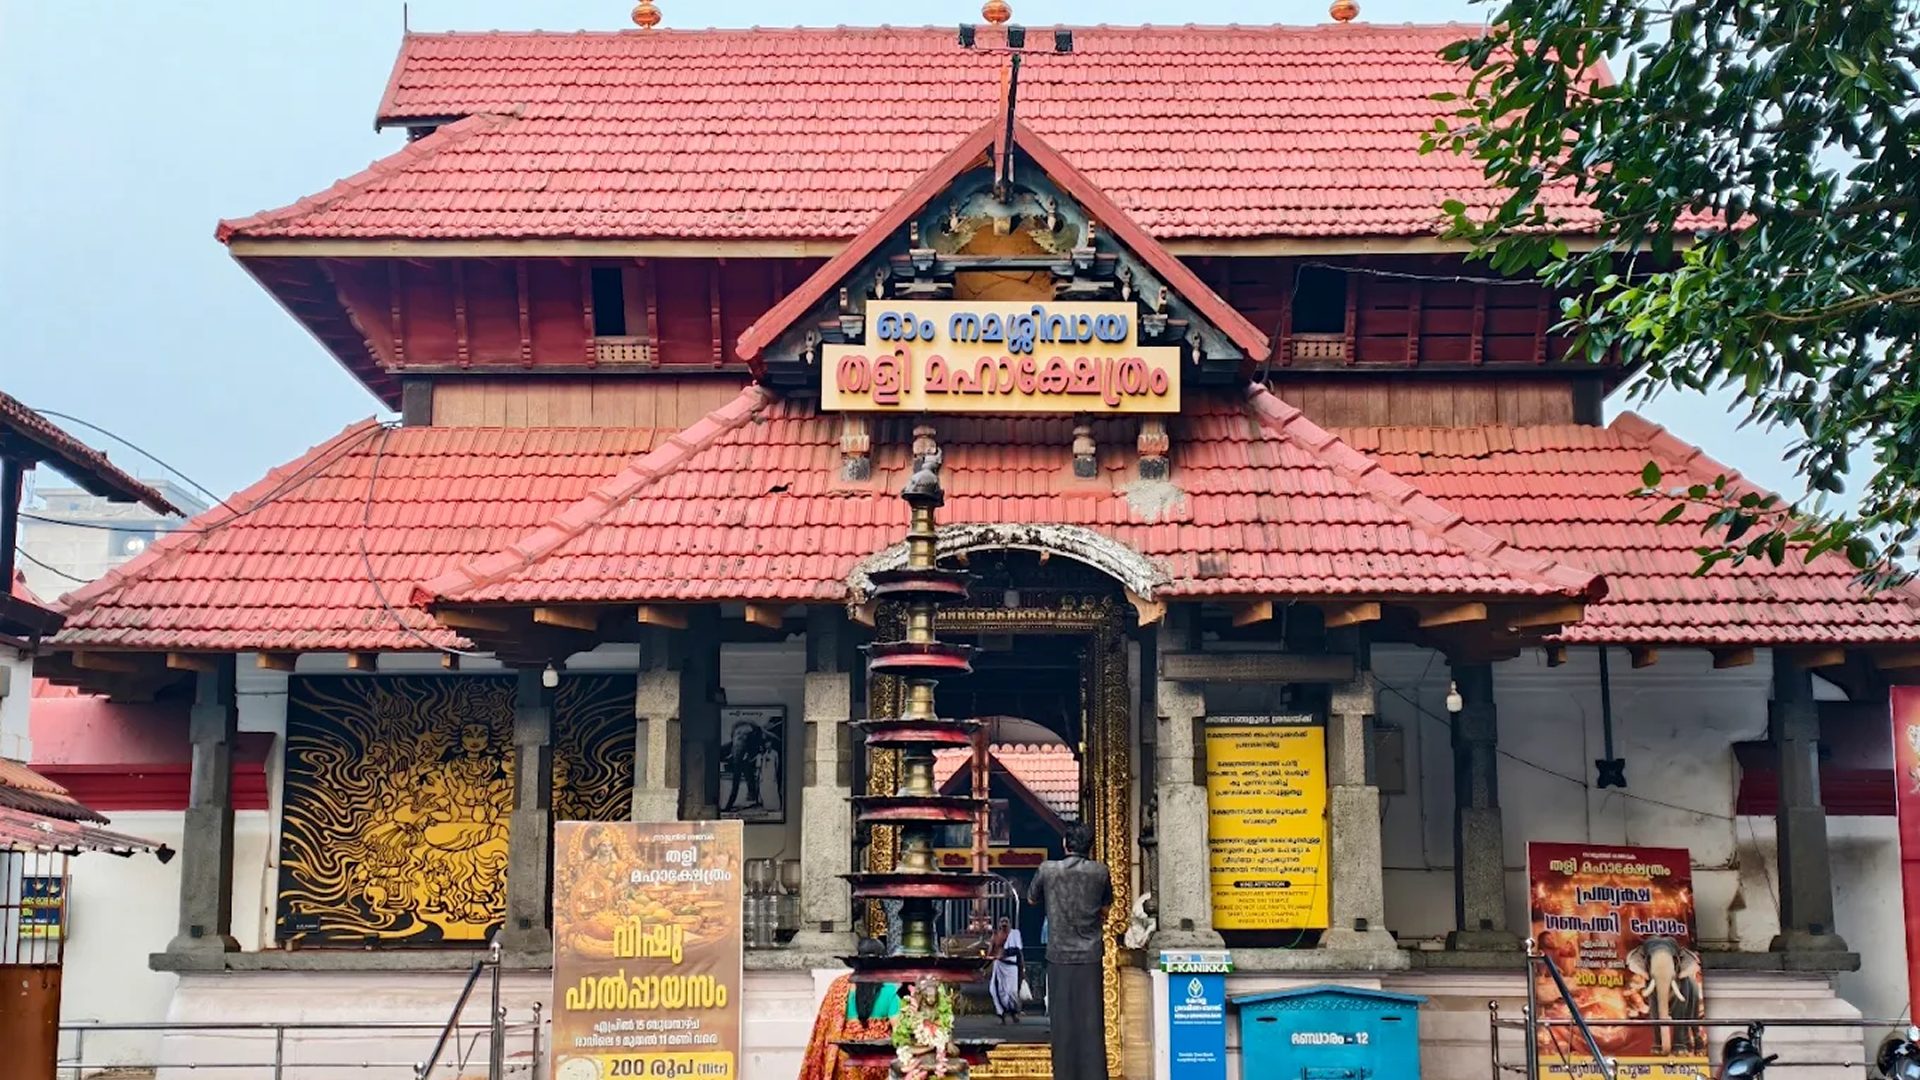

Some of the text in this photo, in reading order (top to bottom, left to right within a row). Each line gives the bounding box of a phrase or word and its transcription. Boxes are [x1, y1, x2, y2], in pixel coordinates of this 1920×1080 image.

[876, 311, 935, 340] ഓം
[836, 343, 1169, 407] തളി മഹാക്ഷേത്രം
[665, 846, 698, 867] തളി
[630, 868, 731, 885] മഹാക്ഷേത്രം
[1549, 858, 1671, 879] തളി മഹാക്ഷേത്രം
[1544, 911, 1687, 935] ഗണപതി ഹോമം
[613, 915, 685, 965] വിഷു
[565, 968, 727, 1011] പാൽപ്പായസം
[594, 1018, 634, 1033] ഏപ്രിൽ
[635, 1019, 645, 1030] 15
[667, 1032, 693, 1045] മണി
[1290, 1032, 1345, 1045] ഭണ്ഡാരം
[1355, 1032, 1369, 1045] 12
[610, 1058, 645, 1077] 200
[650, 1058, 693, 1079] രൂപ
